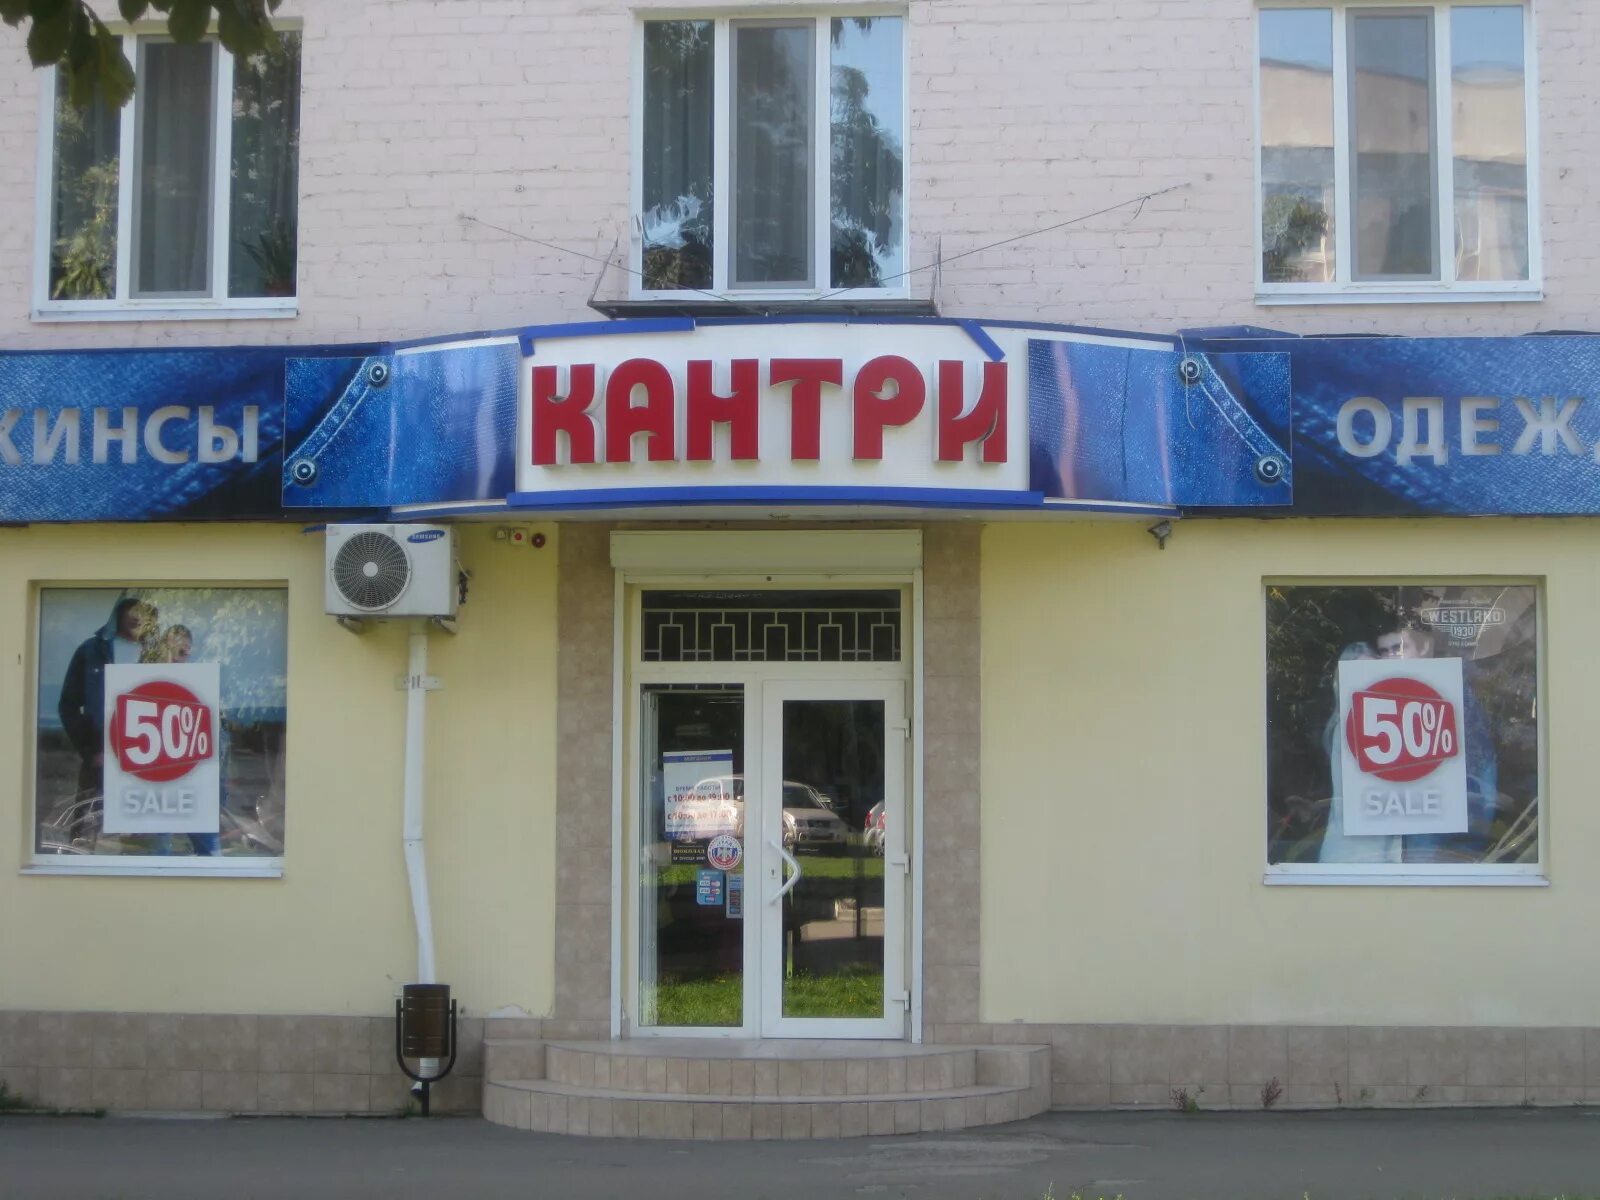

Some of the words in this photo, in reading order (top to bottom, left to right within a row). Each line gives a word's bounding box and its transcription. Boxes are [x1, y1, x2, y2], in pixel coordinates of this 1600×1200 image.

[532, 355, 1008, 465] КАНТРИ
[1337, 396, 1600, 466] ОДЕЖ
[1428, 610, 1501, 623] WESTLAND
[1452, 626, 1474, 637] 1930
[124, 699, 208, 765] 50%
[1363, 697, 1452, 765] 50%
[124, 788, 195, 814] SALE
[1366, 789, 1441, 816] SALE
